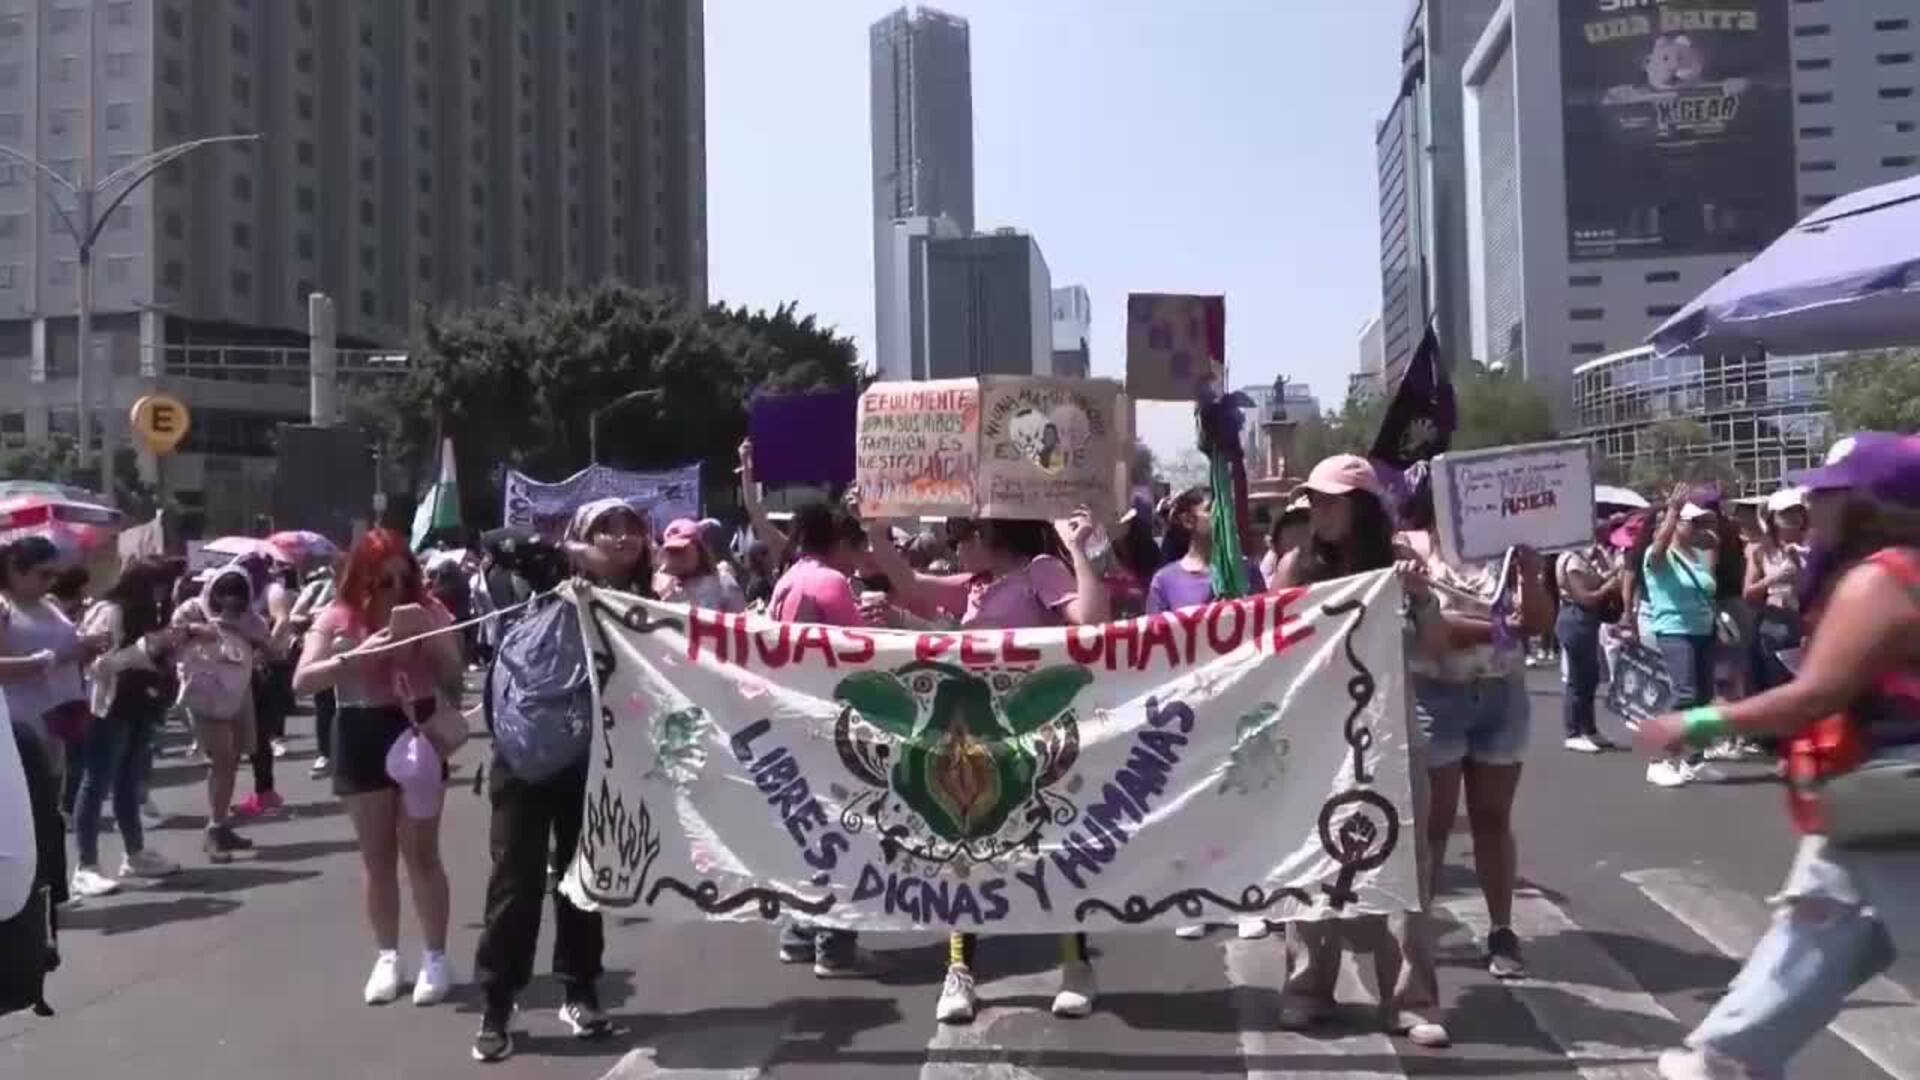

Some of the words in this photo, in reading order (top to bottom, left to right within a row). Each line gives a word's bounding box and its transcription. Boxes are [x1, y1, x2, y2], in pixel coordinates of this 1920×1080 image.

[1583, 16, 1649, 43] una
[1659, 5, 1757, 30] barra
[152, 404, 174, 431] E
[687, 608, 876, 670] HIJAS
[851, 862, 1011, 926] DIGNAS
[1015, 856, 1053, 914] Y
[1052, 695, 1196, 890] HUMANAS
